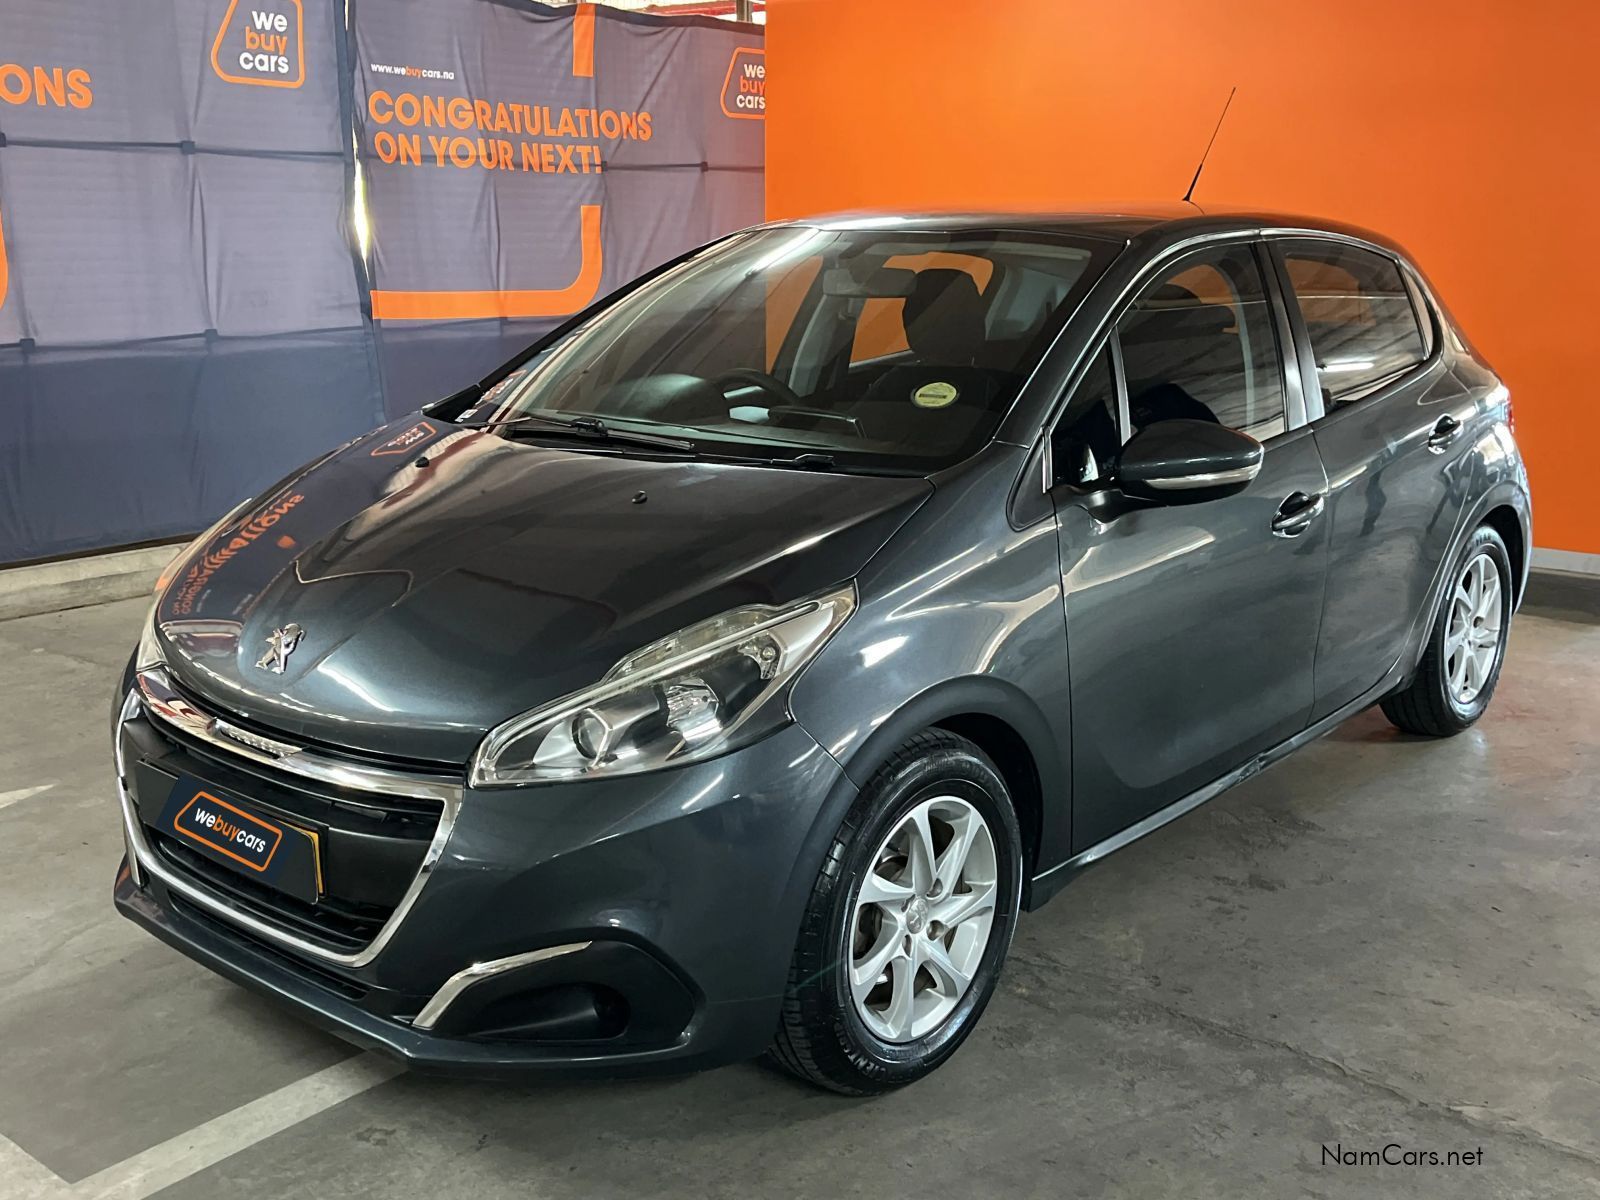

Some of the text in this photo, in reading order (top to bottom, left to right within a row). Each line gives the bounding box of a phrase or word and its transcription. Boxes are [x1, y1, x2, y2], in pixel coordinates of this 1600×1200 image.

[252, 11, 287, 32] we
[245, 26, 287, 55] buy
[239, 51, 289, 74] cars
[371, 64, 455, 80] www.webuycars.na
[744, 64, 765, 78] we
[0, 64, 93, 109] ONS
[736, 95, 765, 109] cars
[368, 90, 653, 142] CONGRATULATIONS
[374, 131, 602, 174] ON YOUR NEXT!
